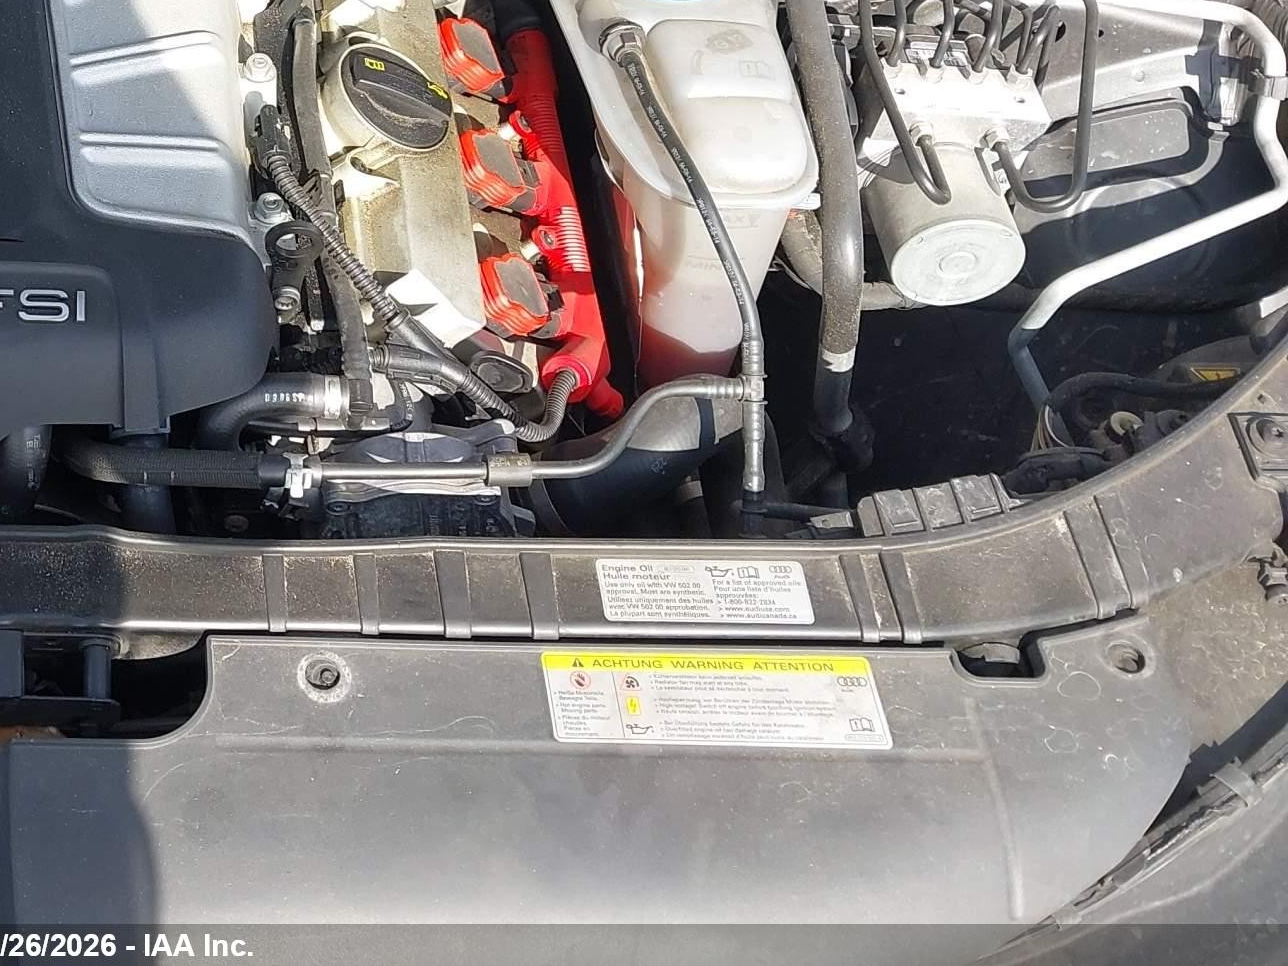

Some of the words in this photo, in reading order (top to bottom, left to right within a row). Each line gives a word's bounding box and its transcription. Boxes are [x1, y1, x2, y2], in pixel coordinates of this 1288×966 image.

[602, 564, 636, 573] Engine
[639, 564, 654, 572] Oil
[603, 572, 629, 580] Huile
[620, 581, 635, 589] only
[753, 579, 787, 587] approved
[635, 597, 677, 605] uniquement
[592, 659, 663, 670] ACHTUNG
[670, 660, 744, 671] WARNING
[753, 661, 834, 672] ATTENTION
